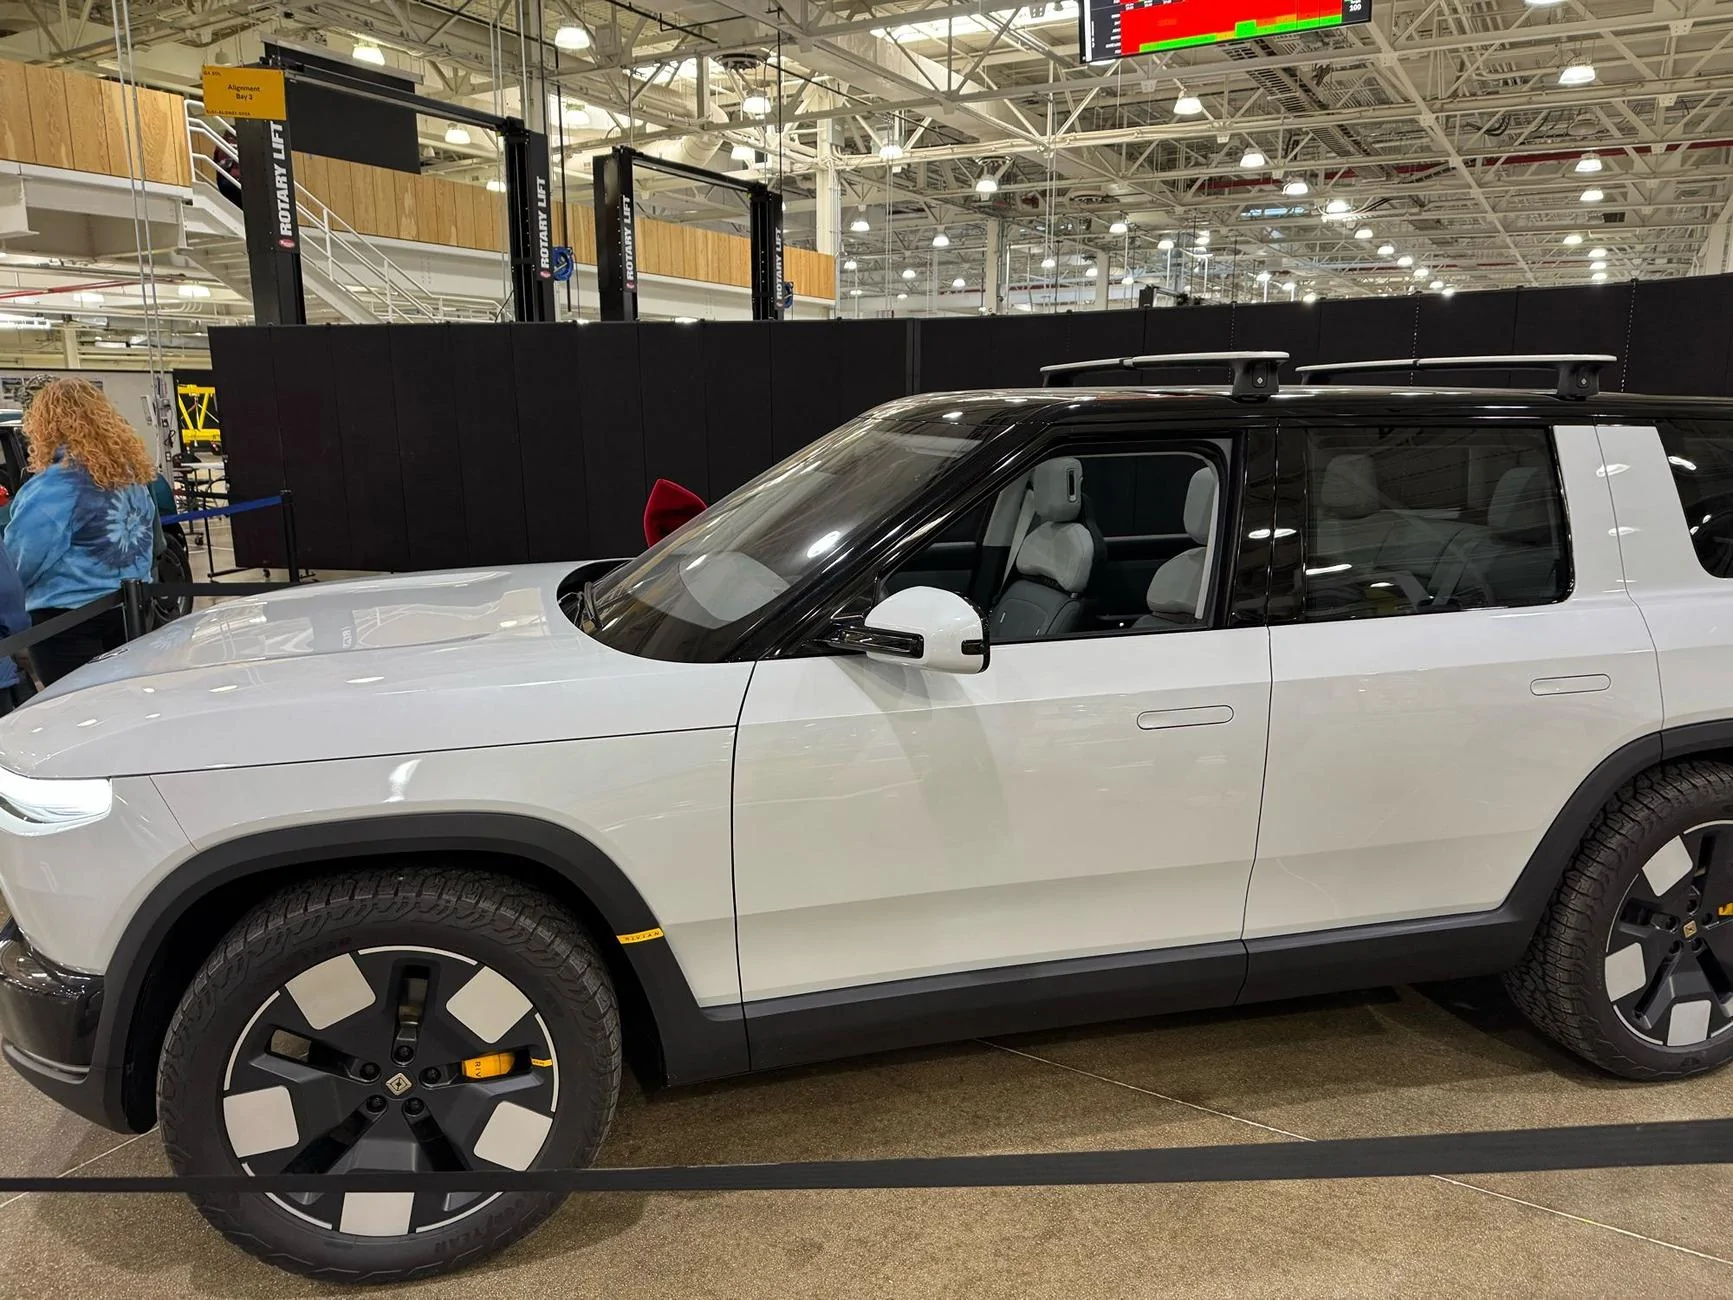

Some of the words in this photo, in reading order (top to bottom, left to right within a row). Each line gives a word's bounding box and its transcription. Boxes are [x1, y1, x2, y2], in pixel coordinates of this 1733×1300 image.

[227, 83, 261, 92] Alignment
[270, 120, 286, 160] LIFT
[273, 163, 293, 237] ROTARY
[536, 176, 547, 208] LIFT
[622, 195, 632, 224] LIFT
[538, 210, 550, 269] ROTARY
[624, 227, 634, 280] ROTARY
[775, 254, 783, 300] ROTARY
